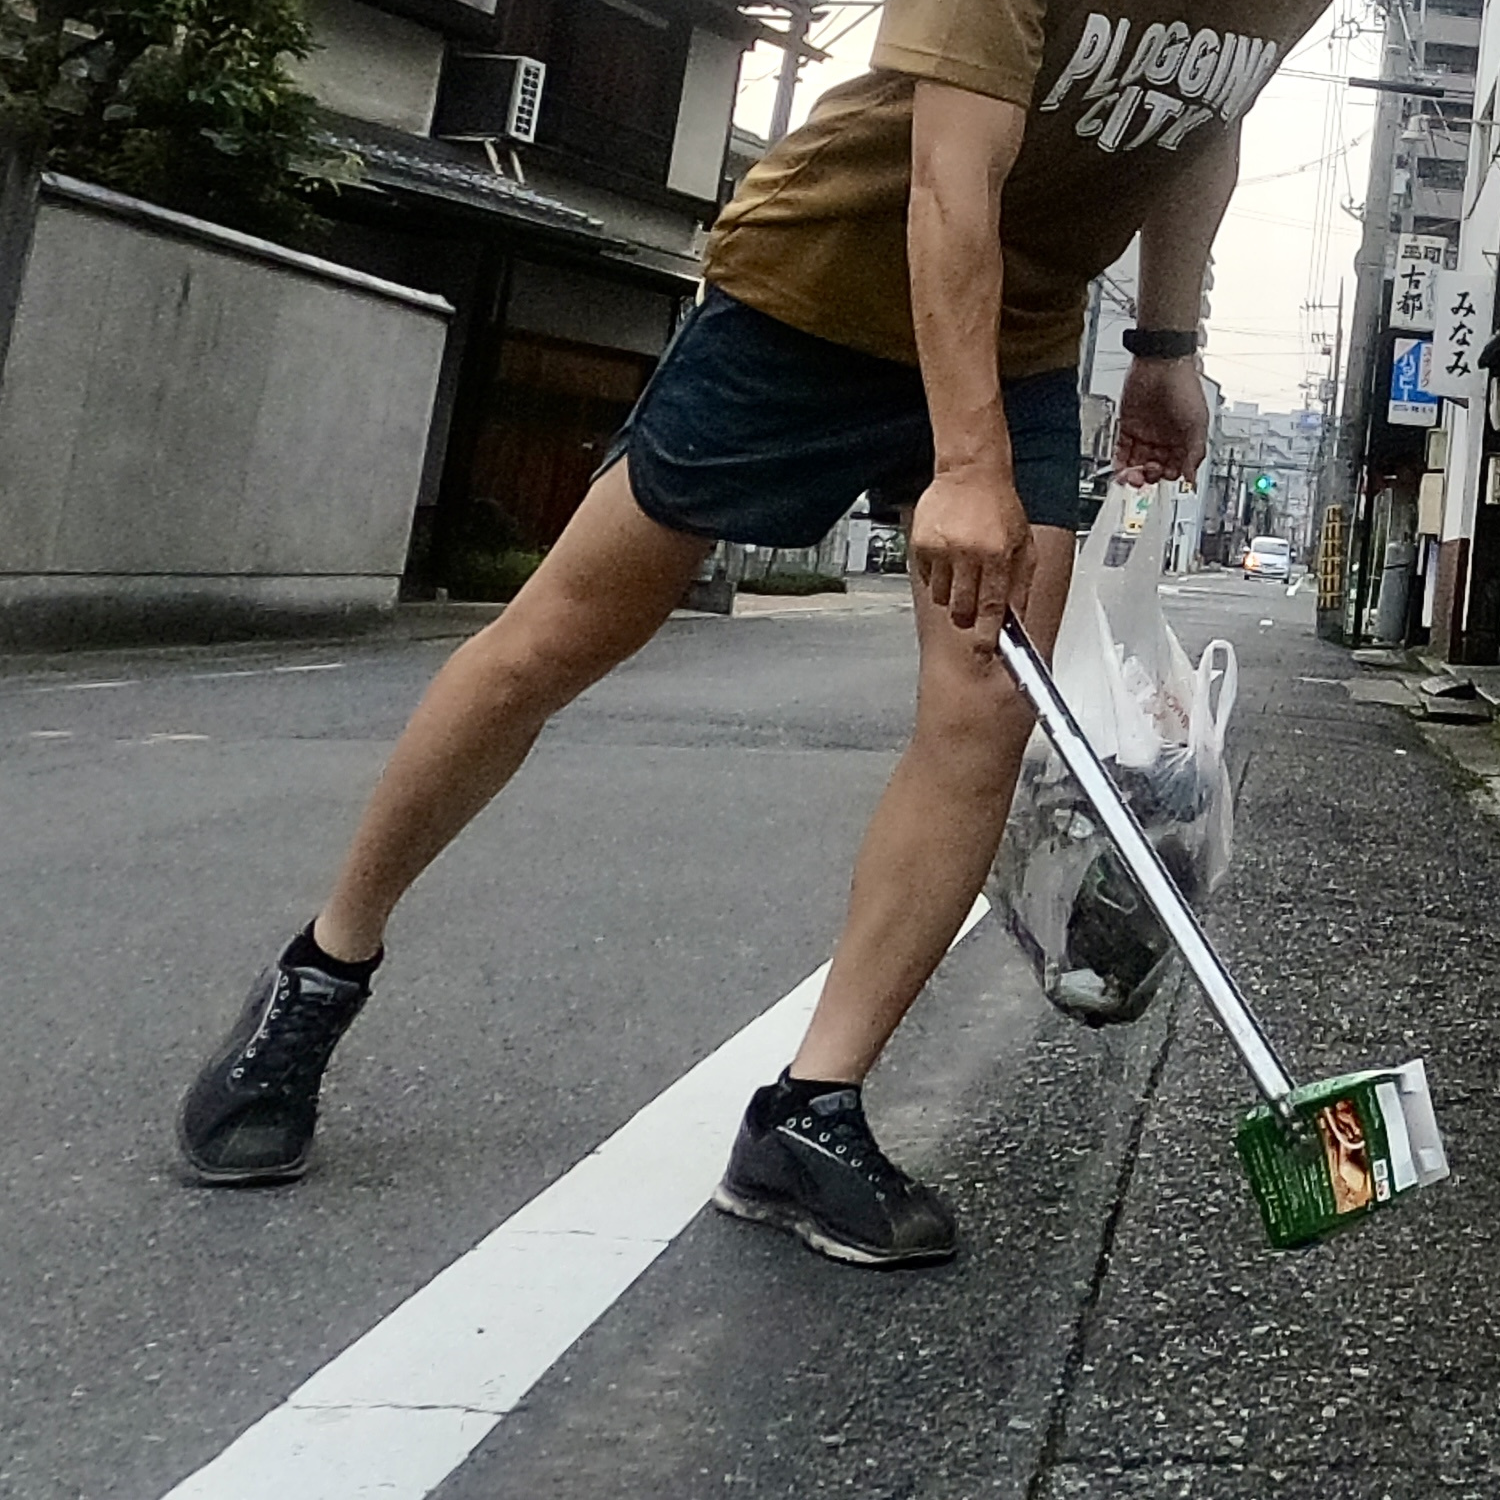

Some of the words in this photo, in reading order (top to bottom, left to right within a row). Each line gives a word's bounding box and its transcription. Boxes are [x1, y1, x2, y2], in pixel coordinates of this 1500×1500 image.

[1075, 85, 1214, 153] CITY
[1396, 263, 1427, 321] 古都
[1444, 290, 1477, 378] みなみ
